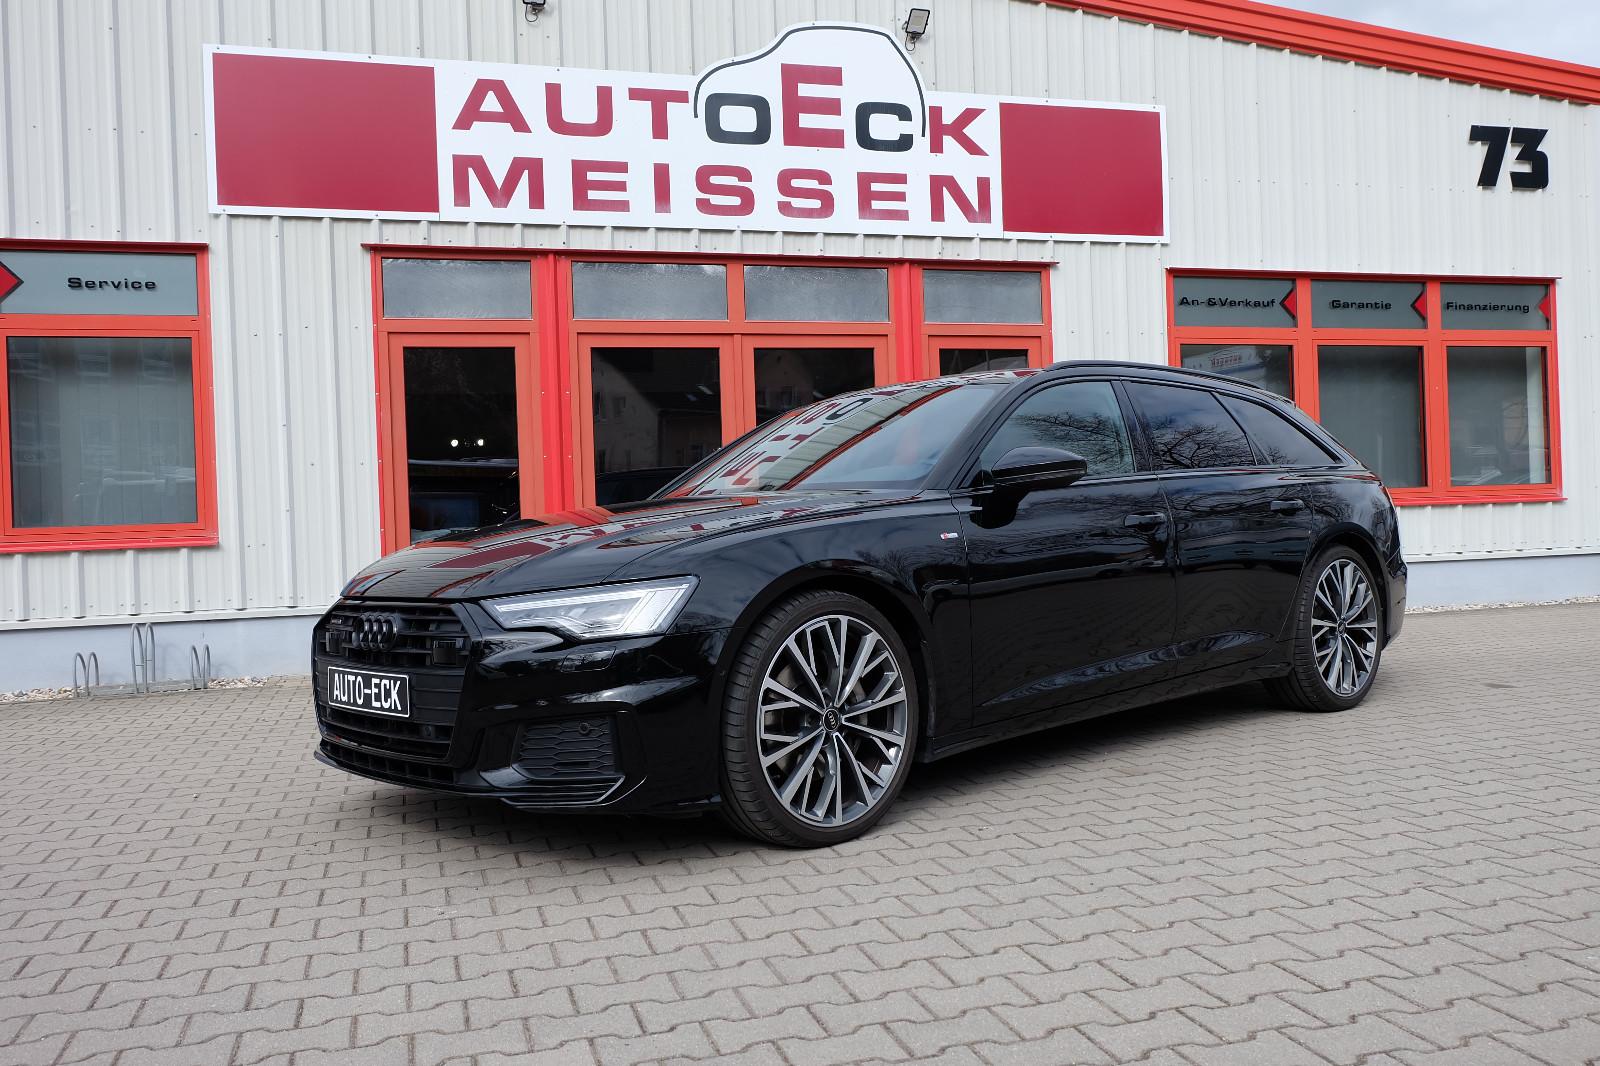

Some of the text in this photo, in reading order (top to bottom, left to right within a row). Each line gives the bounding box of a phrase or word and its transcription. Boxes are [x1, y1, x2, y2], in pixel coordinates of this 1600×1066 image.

[1469, 124, 1549, 190] 73
[452, 155, 992, 223] MEISSEN
[67, 277, 157, 290] Service
[1331, 299, 1392, 310] Garantie
[1445, 301, 1530, 314] Finanzierung
[333, 672, 402, 711] AUTO-ECK
